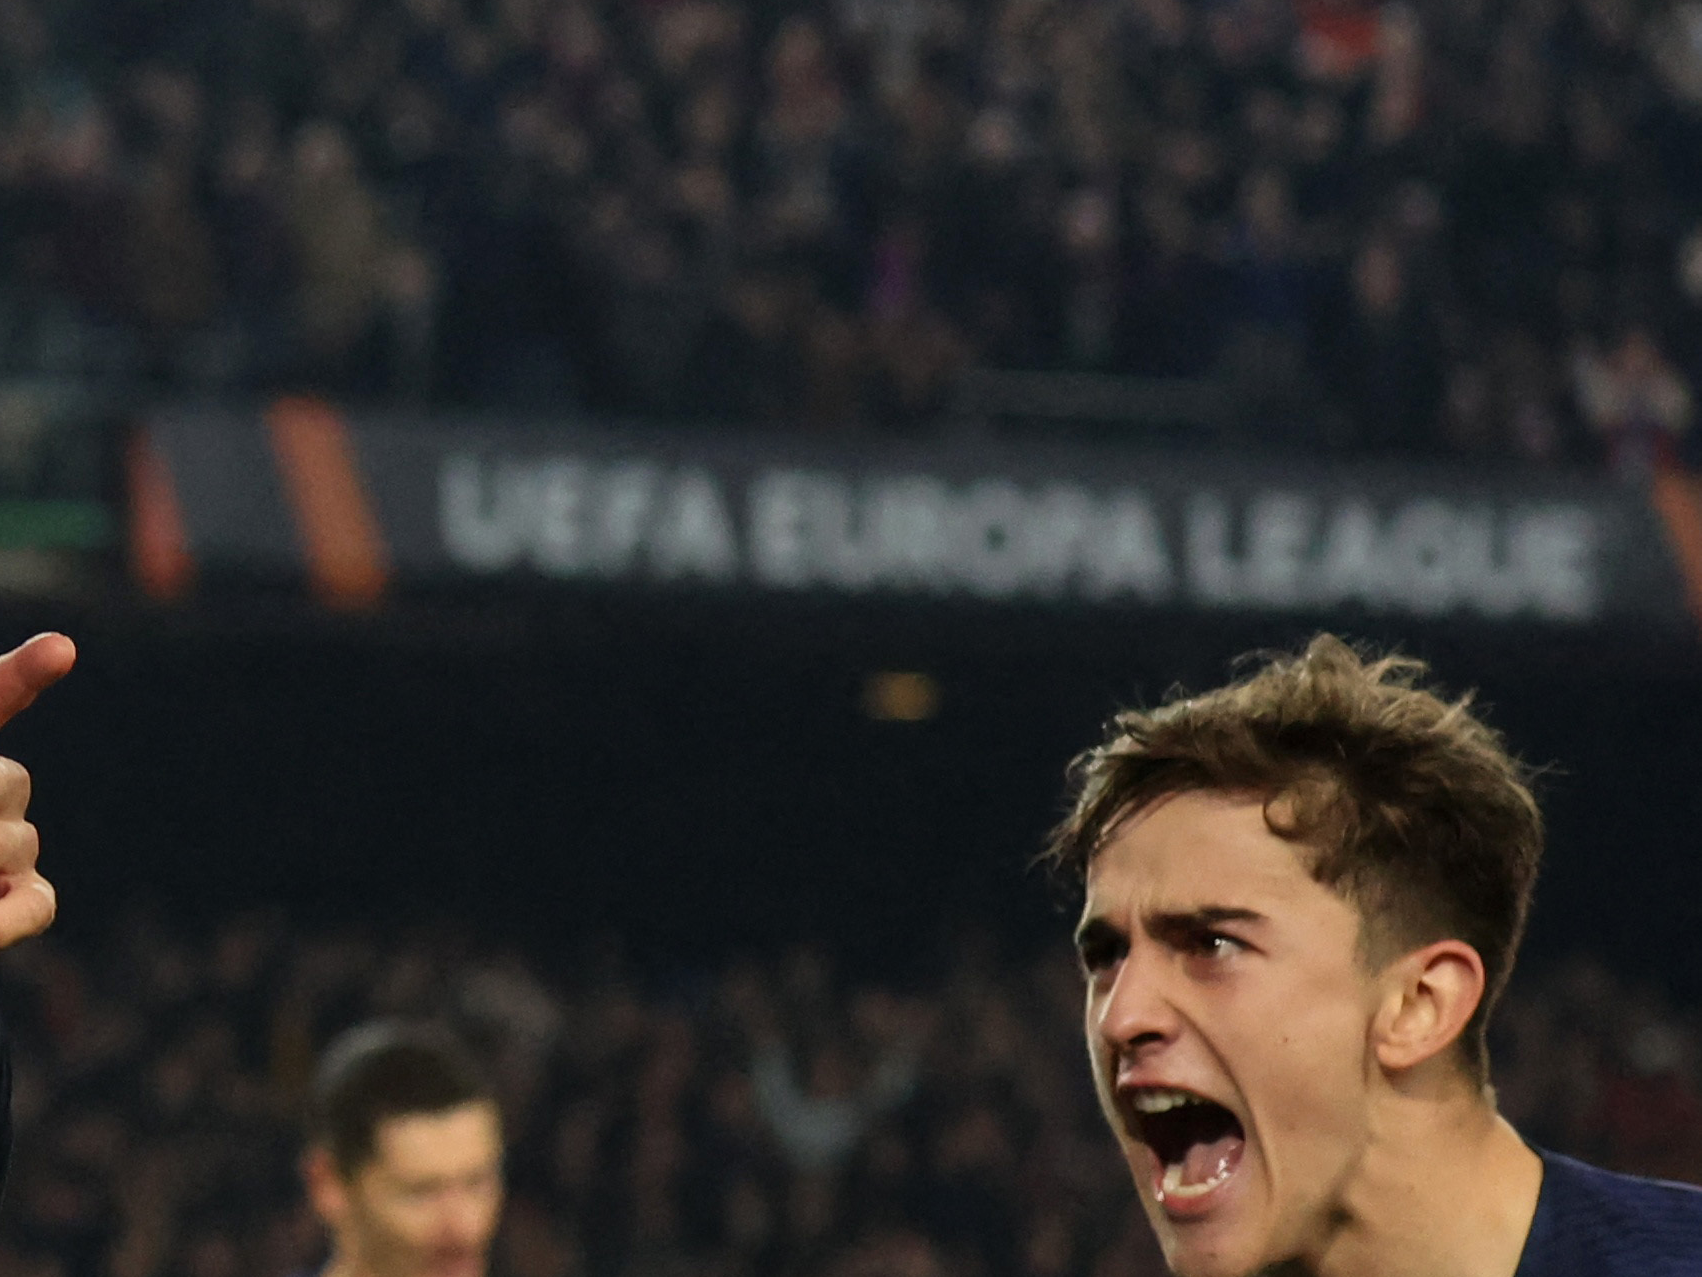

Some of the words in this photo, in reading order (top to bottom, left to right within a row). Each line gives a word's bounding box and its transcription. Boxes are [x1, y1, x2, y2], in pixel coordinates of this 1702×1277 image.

[437, 454, 733, 580] UEFA
[747, 467, 1165, 602] EUROPA
[1183, 484, 1597, 620] LEAGUE
